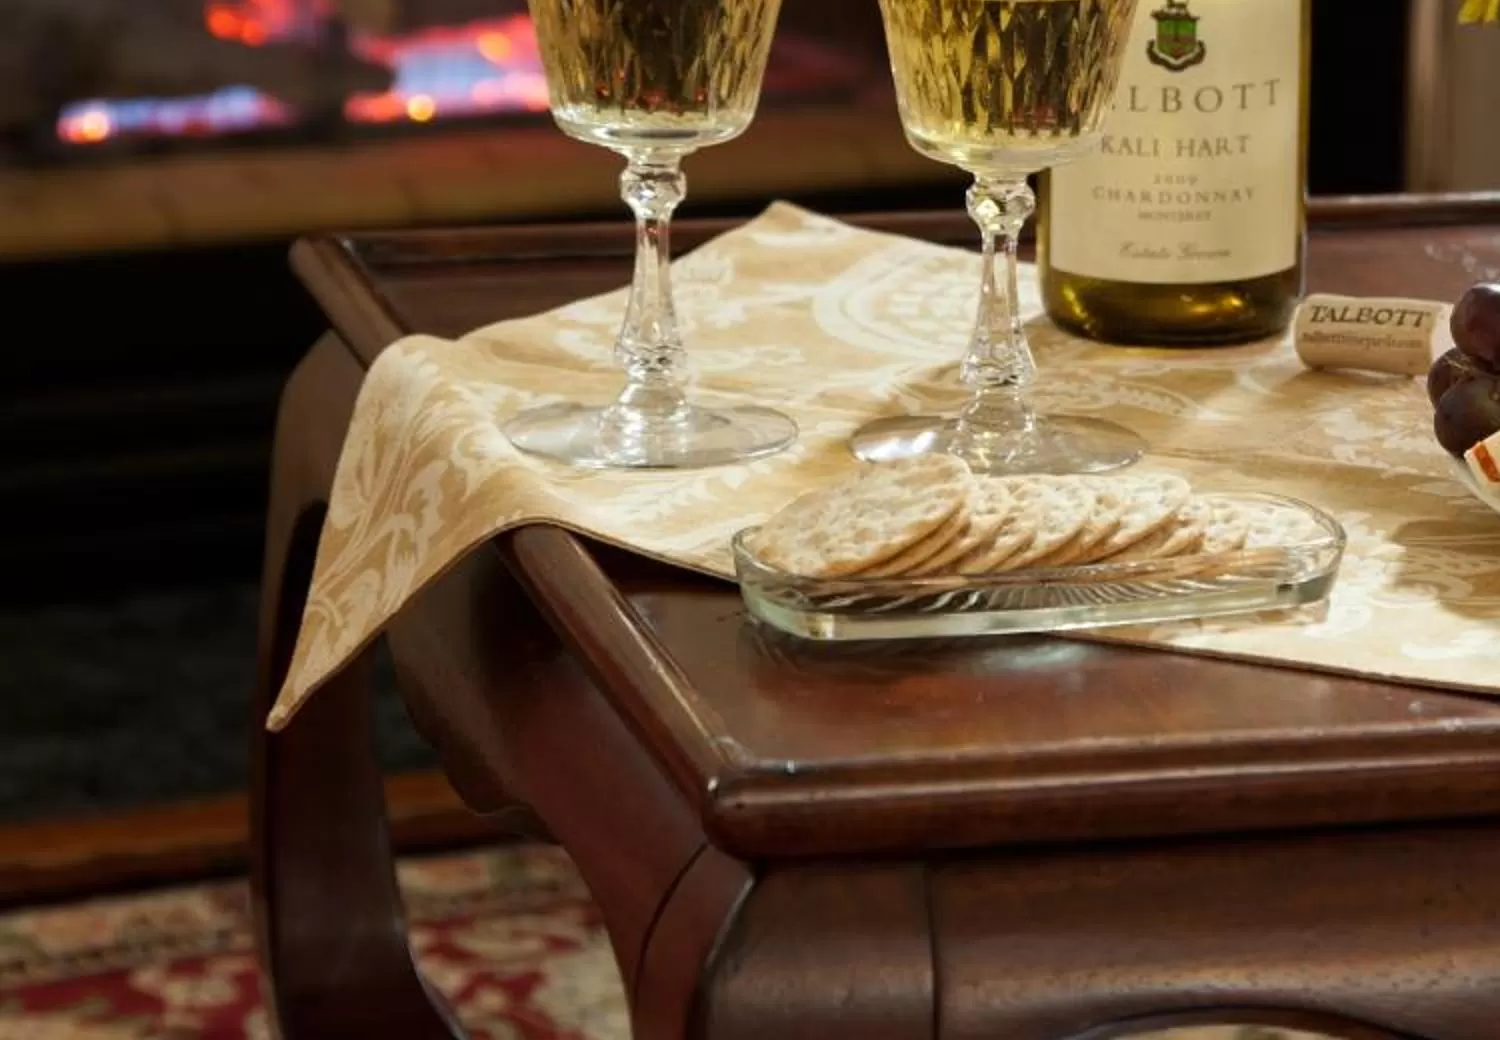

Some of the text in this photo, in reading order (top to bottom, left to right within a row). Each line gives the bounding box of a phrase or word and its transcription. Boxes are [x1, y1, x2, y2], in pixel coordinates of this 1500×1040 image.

[1110, 77, 1280, 113] LBOTT
[1101, 134, 1251, 159] KALI HART
[1091, 185, 1255, 204] CHARDONNAY
[1310, 305, 1431, 328] TALBOTT
